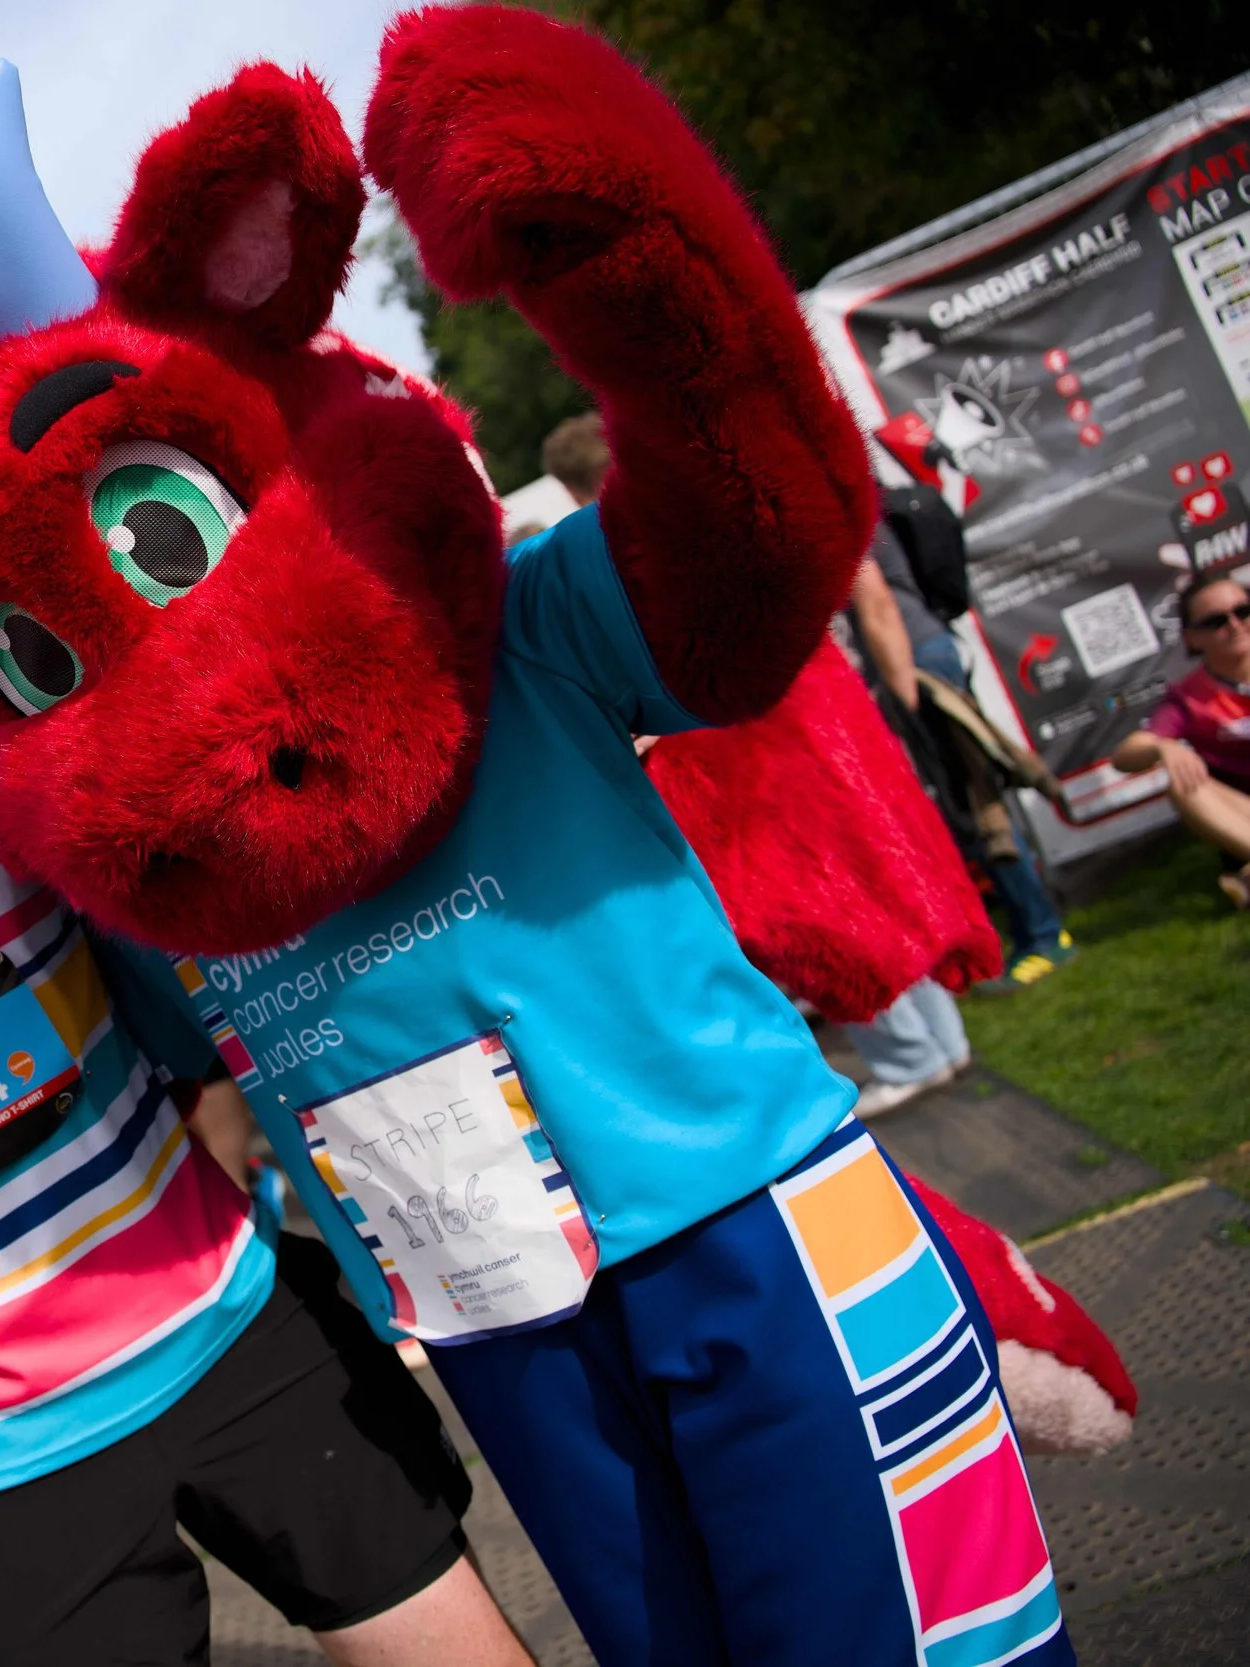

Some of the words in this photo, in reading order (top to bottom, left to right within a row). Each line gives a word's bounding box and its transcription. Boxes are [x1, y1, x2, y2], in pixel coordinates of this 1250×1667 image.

[1159, 187, 1231, 243] MAP
[928, 253, 1052, 329] CARDIFF
[1052, 212, 1131, 273] HALF
[233, 962, 328, 1035] cancer
[332, 872, 505, 984] research
[260, 1018, 344, 1078] wales
[10, 1089, 44, 1114] T-SHIRT
[350, 1098, 479, 1182] STRIPE
[387, 1173, 499, 1249] 1966
[454, 1280, 481, 1293] cymru
[484, 1252, 521, 1273] canser
[486, 1278, 530, 1299] research
